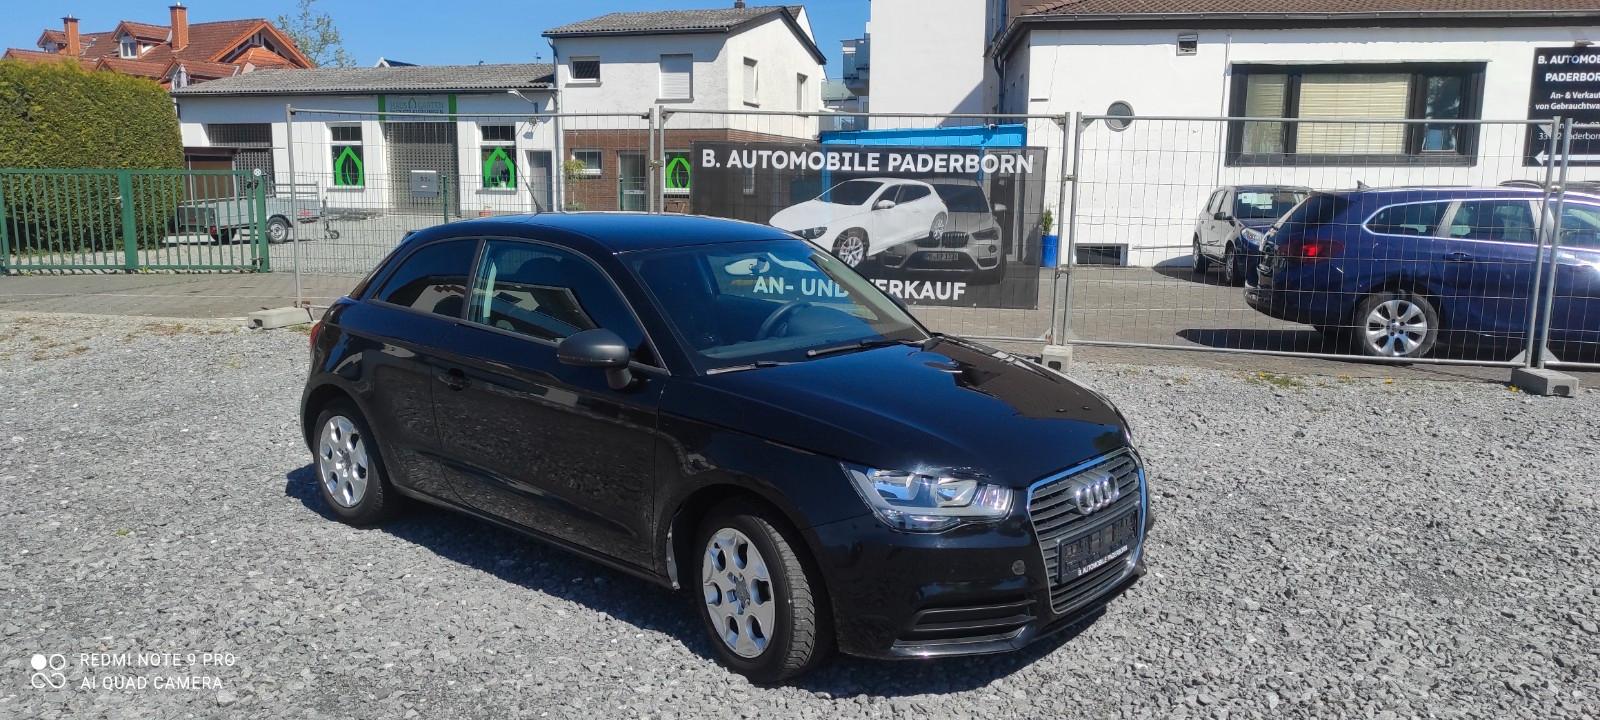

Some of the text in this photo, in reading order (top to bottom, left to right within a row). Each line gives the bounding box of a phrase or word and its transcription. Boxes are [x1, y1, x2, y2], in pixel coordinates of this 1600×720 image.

[1538, 55, 1547, 64] B.
[702, 149, 1035, 174] B. AUTOMOBILE PADERBORN
[753, 276, 794, 294] AN-
